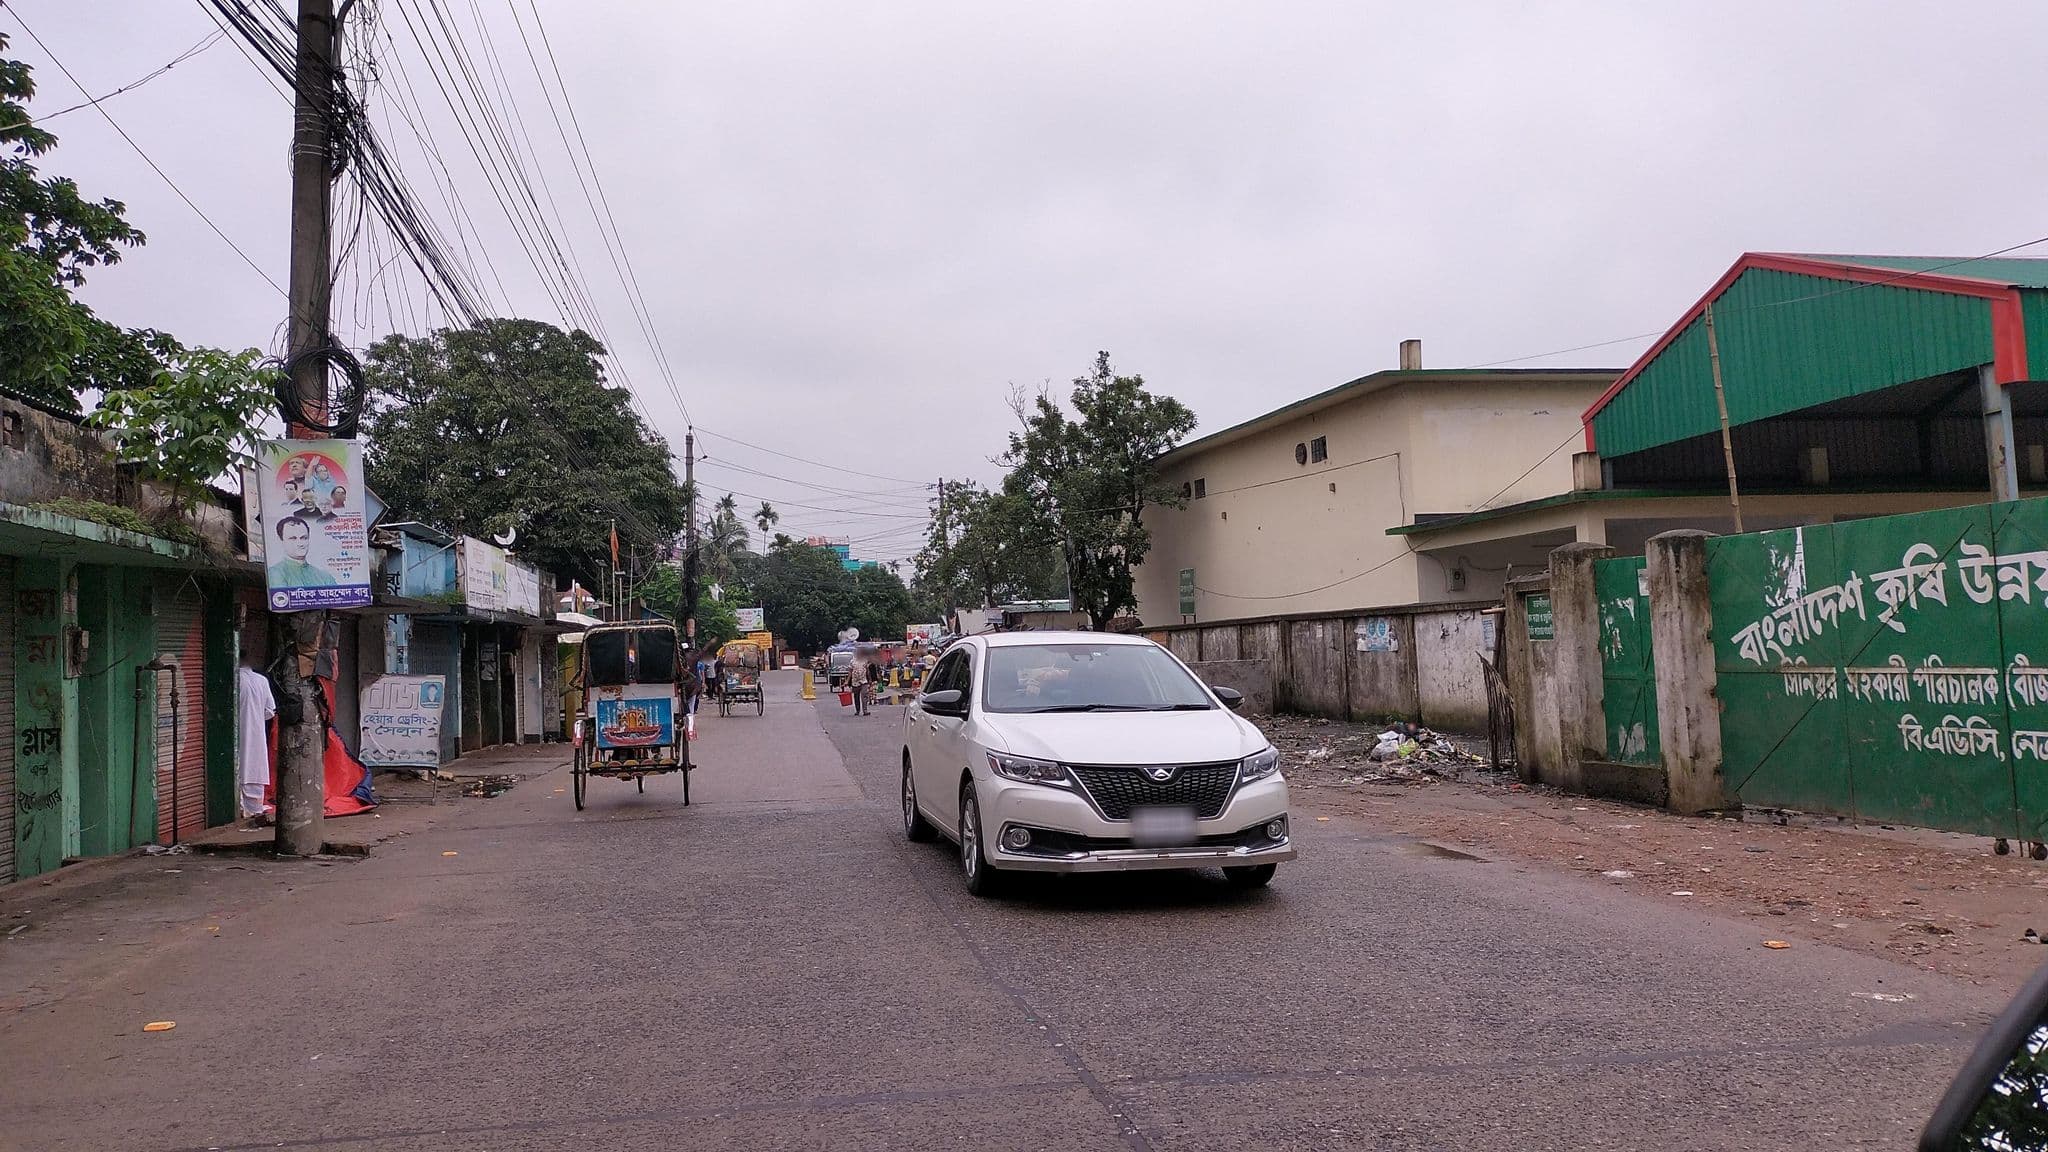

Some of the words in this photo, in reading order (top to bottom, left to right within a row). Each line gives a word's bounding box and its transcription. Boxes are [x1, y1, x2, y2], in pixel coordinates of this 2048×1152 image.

[290, 588, 316, 599] শফিক
[353, 588, 369, 598] বাবু
[1731, 571, 1866, 666] বাংলাদেশ
[1869, 543, 1948, 633] কৃষি
[1781, 656, 1837, 700] সিনিয়র
[1843, 655, 1910, 703] সহকারী
[1912, 655, 1999, 705] পরিচালক
[22, 725, 61, 756] গ্লাস
[375, 726, 424, 737] সেলুন
[1897, 714, 2005, 762] বিএডিসি,
